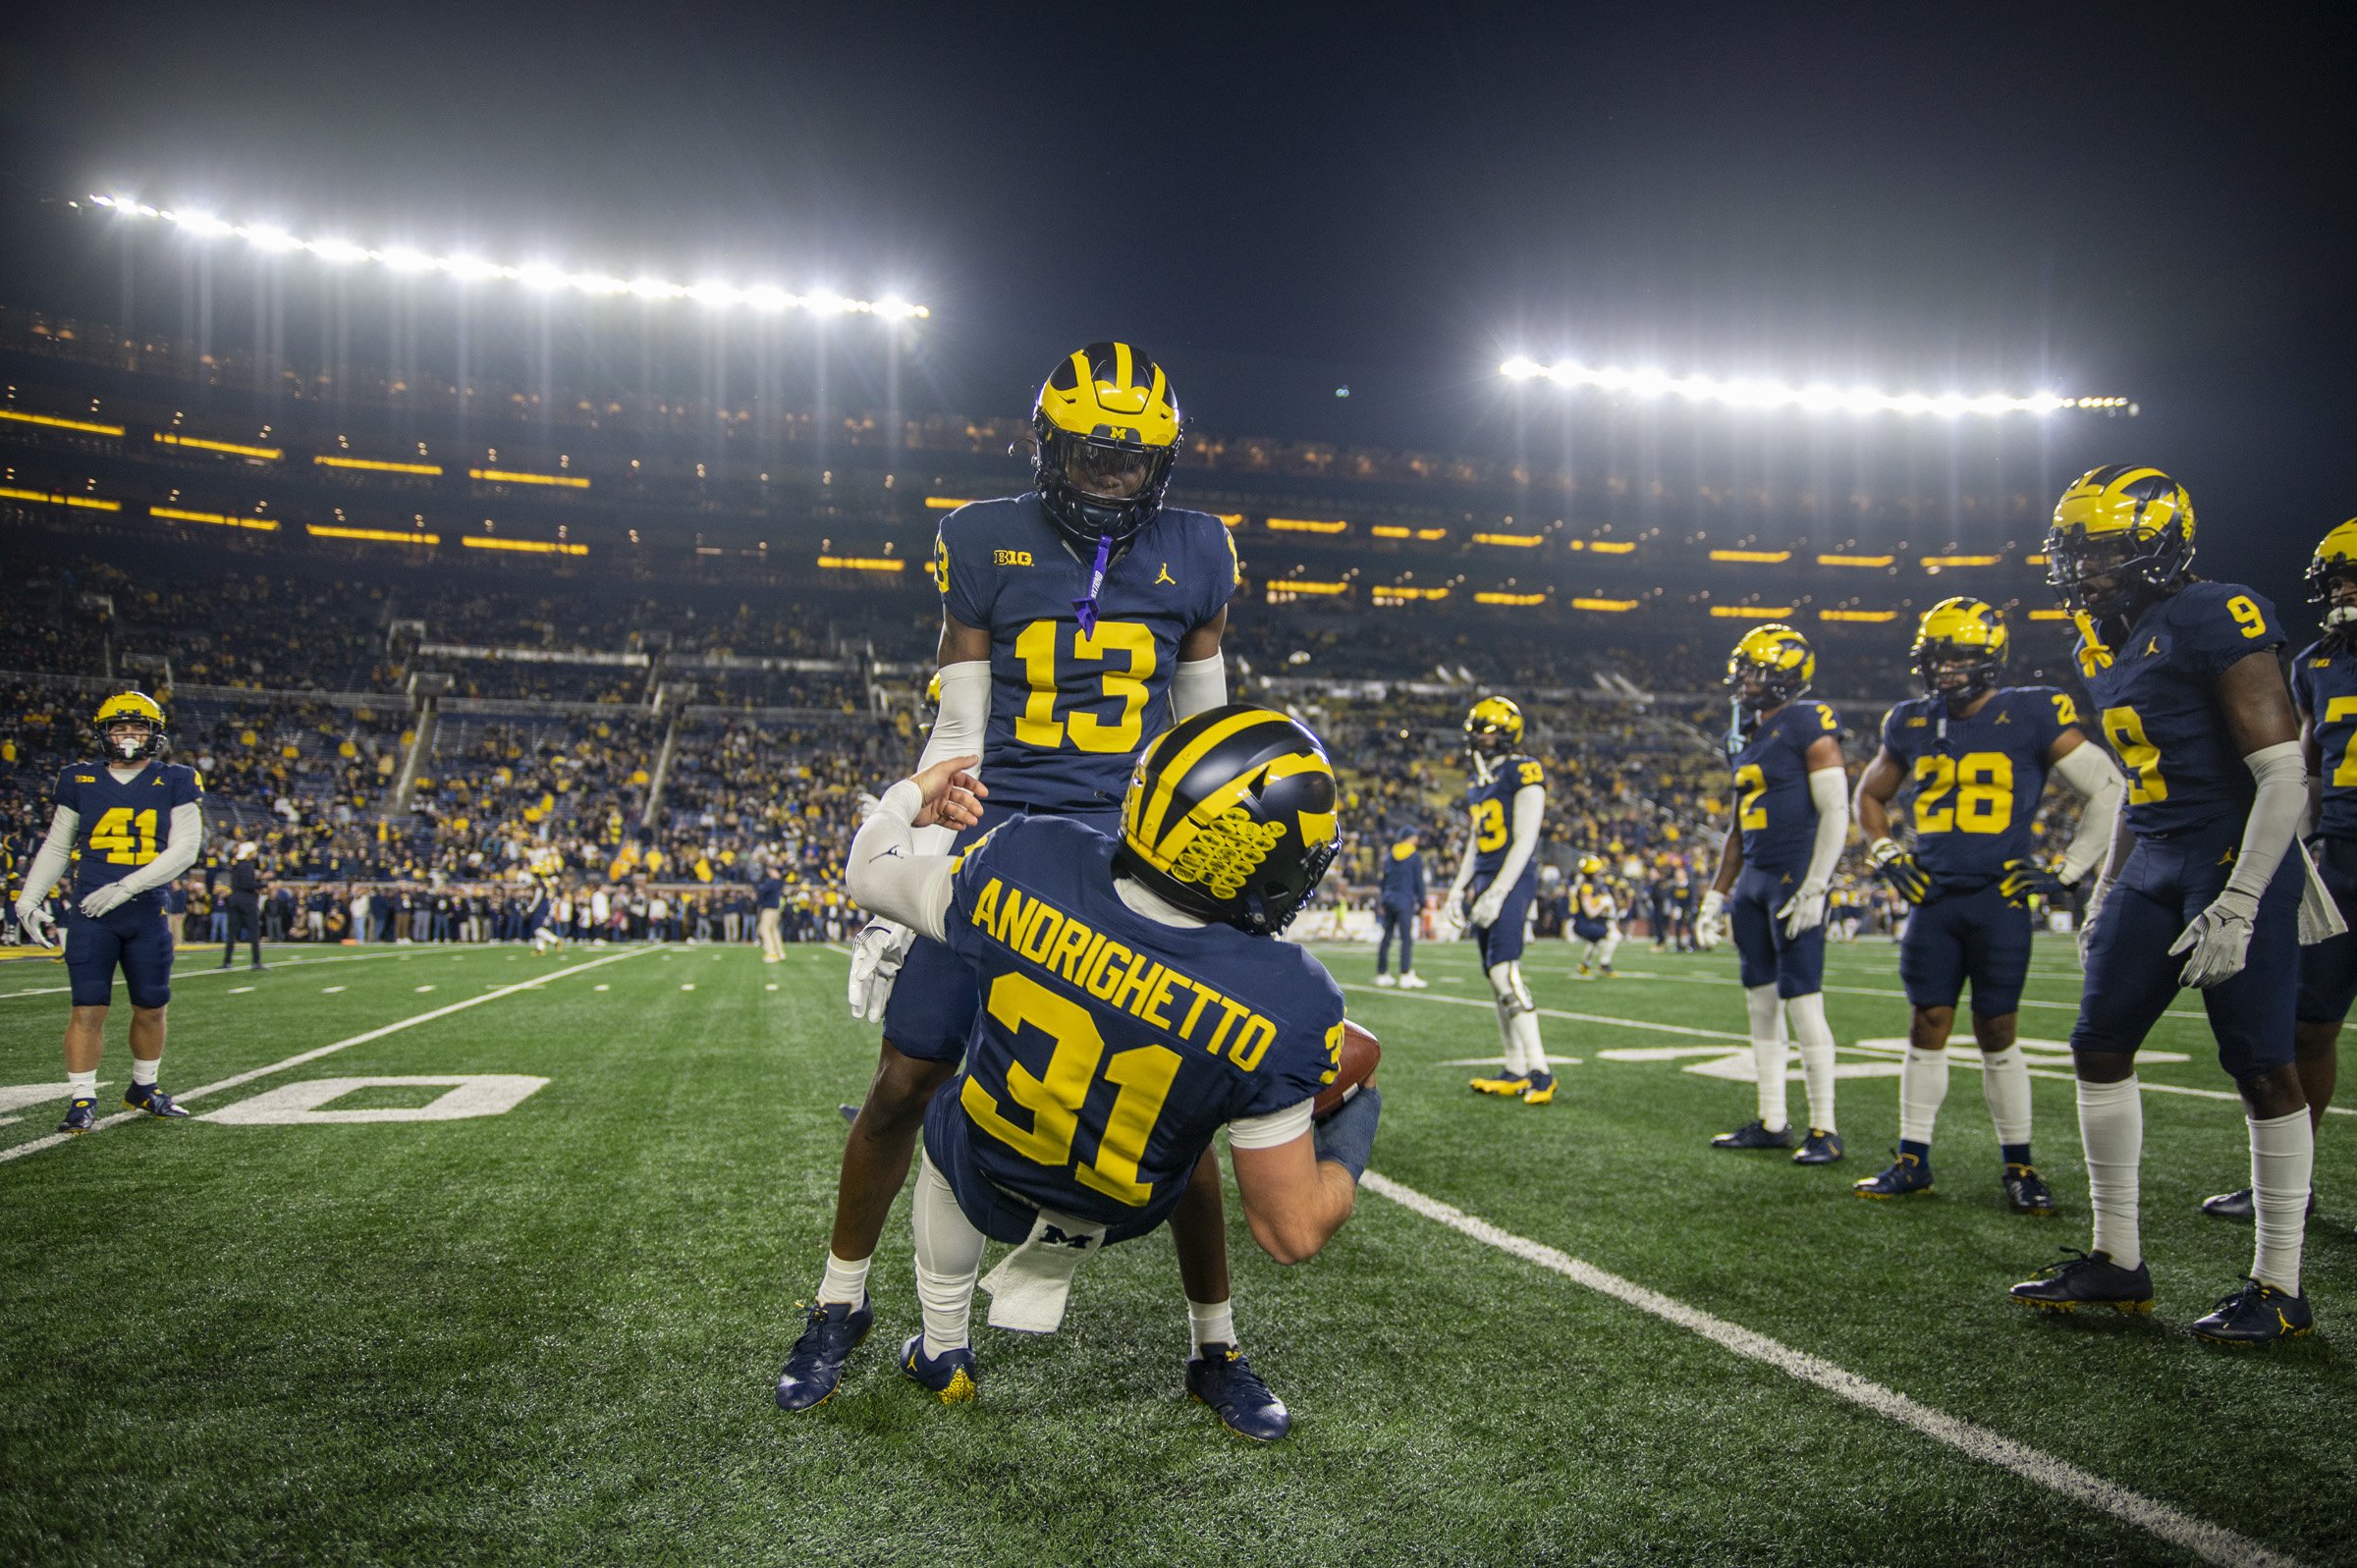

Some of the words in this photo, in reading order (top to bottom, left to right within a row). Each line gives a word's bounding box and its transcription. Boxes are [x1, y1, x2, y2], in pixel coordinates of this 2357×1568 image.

[1110, 426, 1126, 440] M
[2226, 595, 2268, 638] 9
[1014, 620, 1157, 753] 13
[1816, 703, 1837, 730] 2
[1517, 761, 1545, 784] 33
[2102, 705, 2168, 805] 9
[1734, 764, 1768, 831] 2
[1913, 751, 2013, 835] 28
[89, 807, 160, 865] 41
[971, 877, 1278, 1072] ANDRIGHETTO
[960, 971, 1182, 1207] 31
[1038, 1223, 1093, 1249] M
